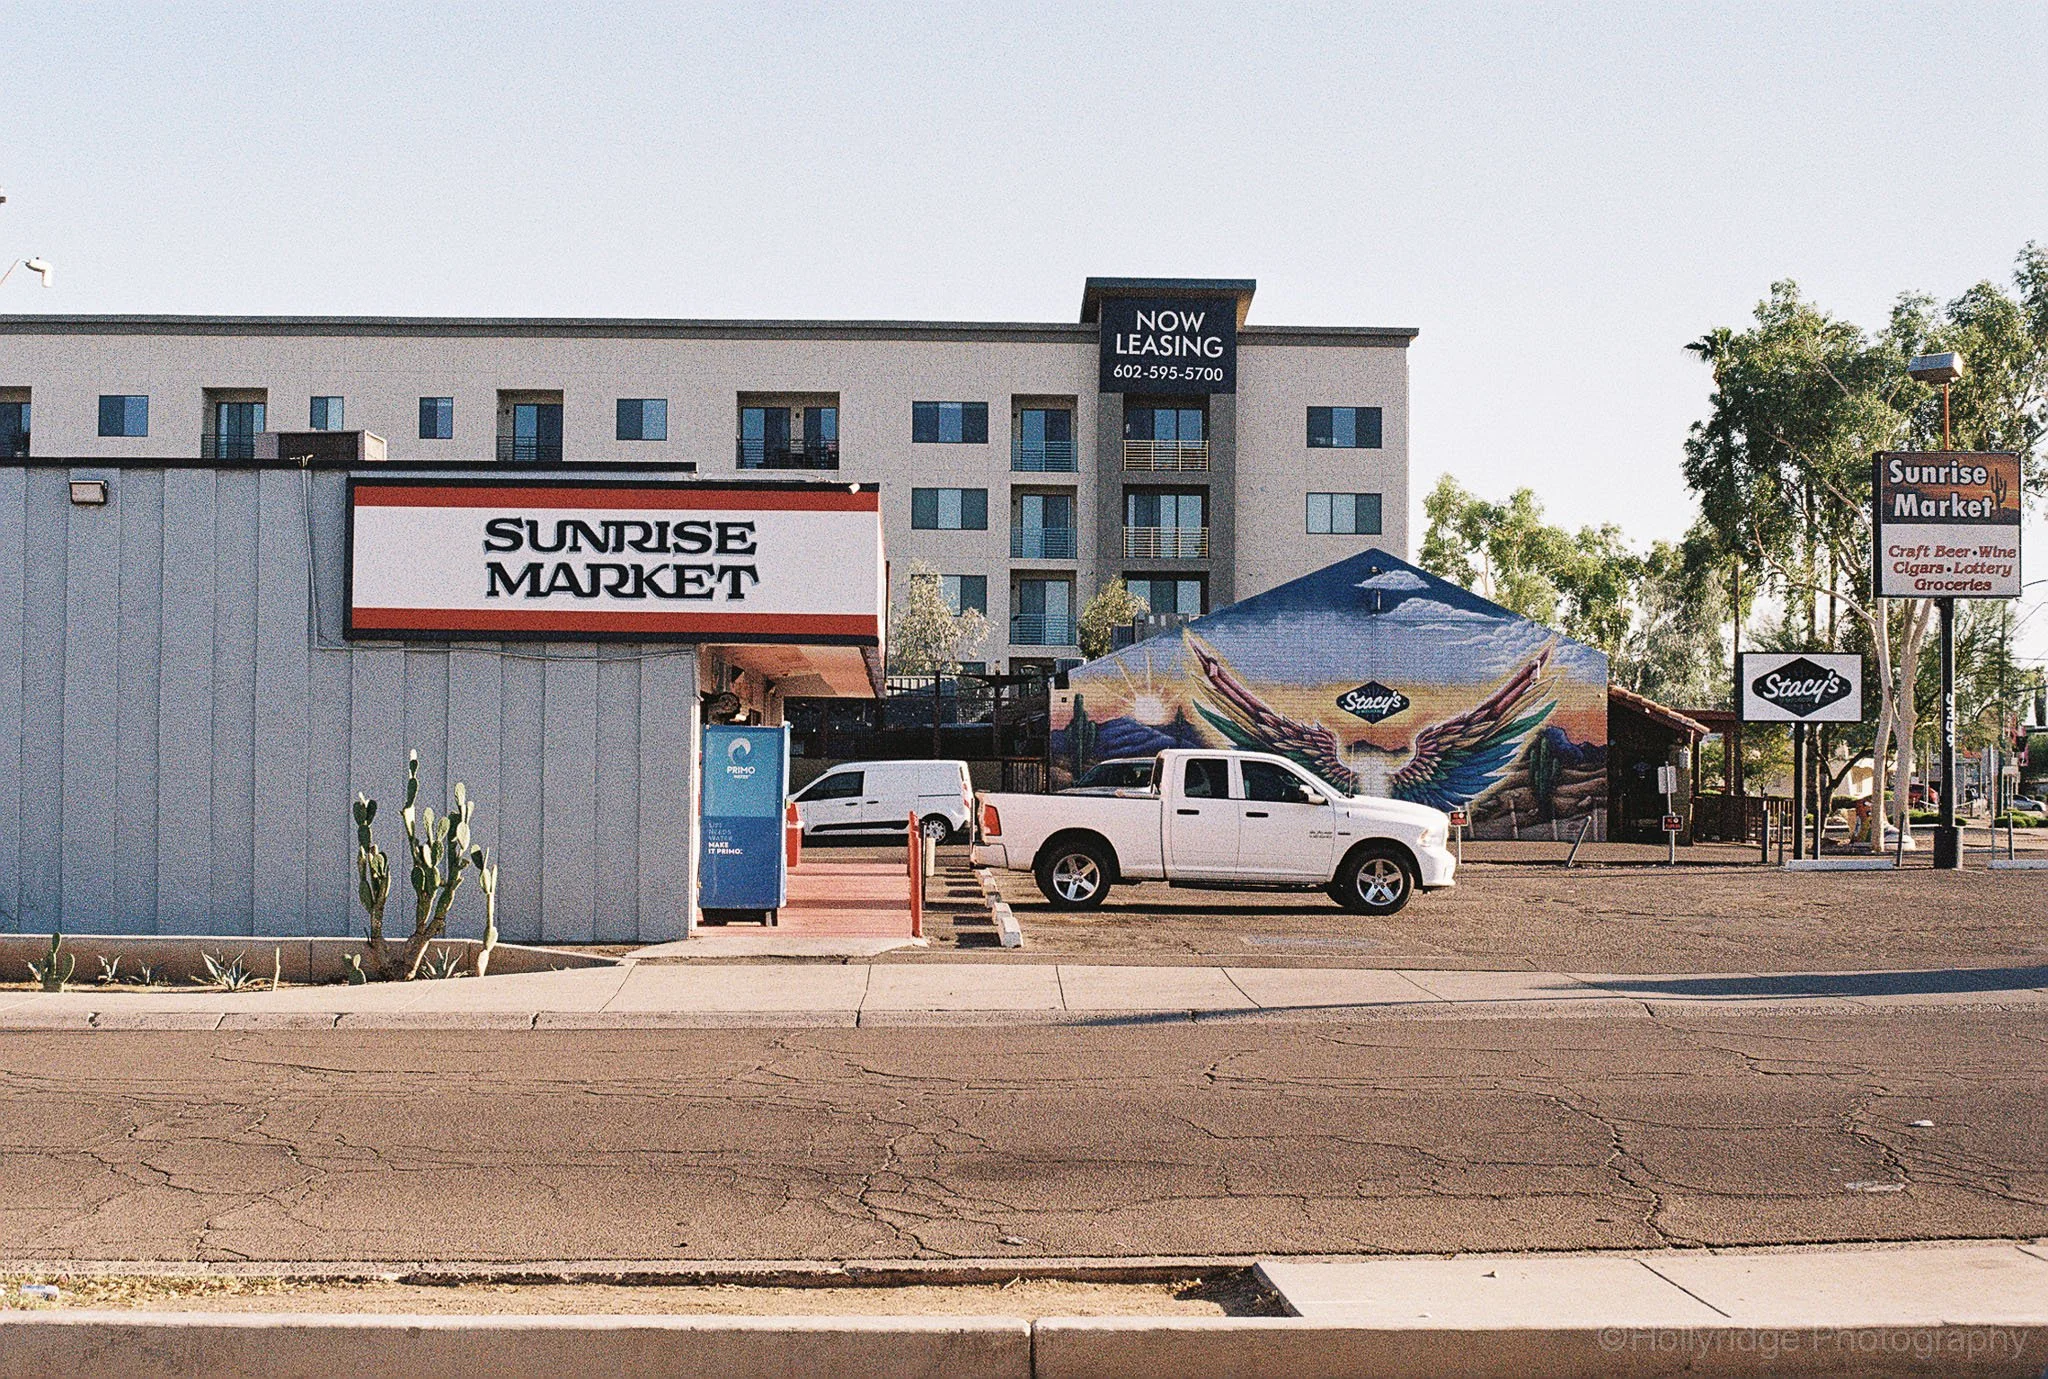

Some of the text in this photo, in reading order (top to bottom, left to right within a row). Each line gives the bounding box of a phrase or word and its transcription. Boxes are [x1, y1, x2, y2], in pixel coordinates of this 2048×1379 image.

[1136, 310, 1206, 333] NOW
[1116, 333, 1224, 359] LEASING
[1113, 364, 1224, 382] 602-595-5700
[1889, 459, 1988, 485] Sunrise
[1893, 492, 1993, 518] Market
[483, 516, 758, 556] SUNRISE
[1888, 545, 2017, 560] Craft Beer Wine
[485, 561, 760, 601] MARKET
[1893, 562, 2013, 578] Cigars Lottery
[1914, 579, 1993, 591] Groceries
[1763, 671, 1840, 704] Stacy's
[1344, 690, 1402, 715] Stacy's
[726, 766, 756, 775] PRIMO
